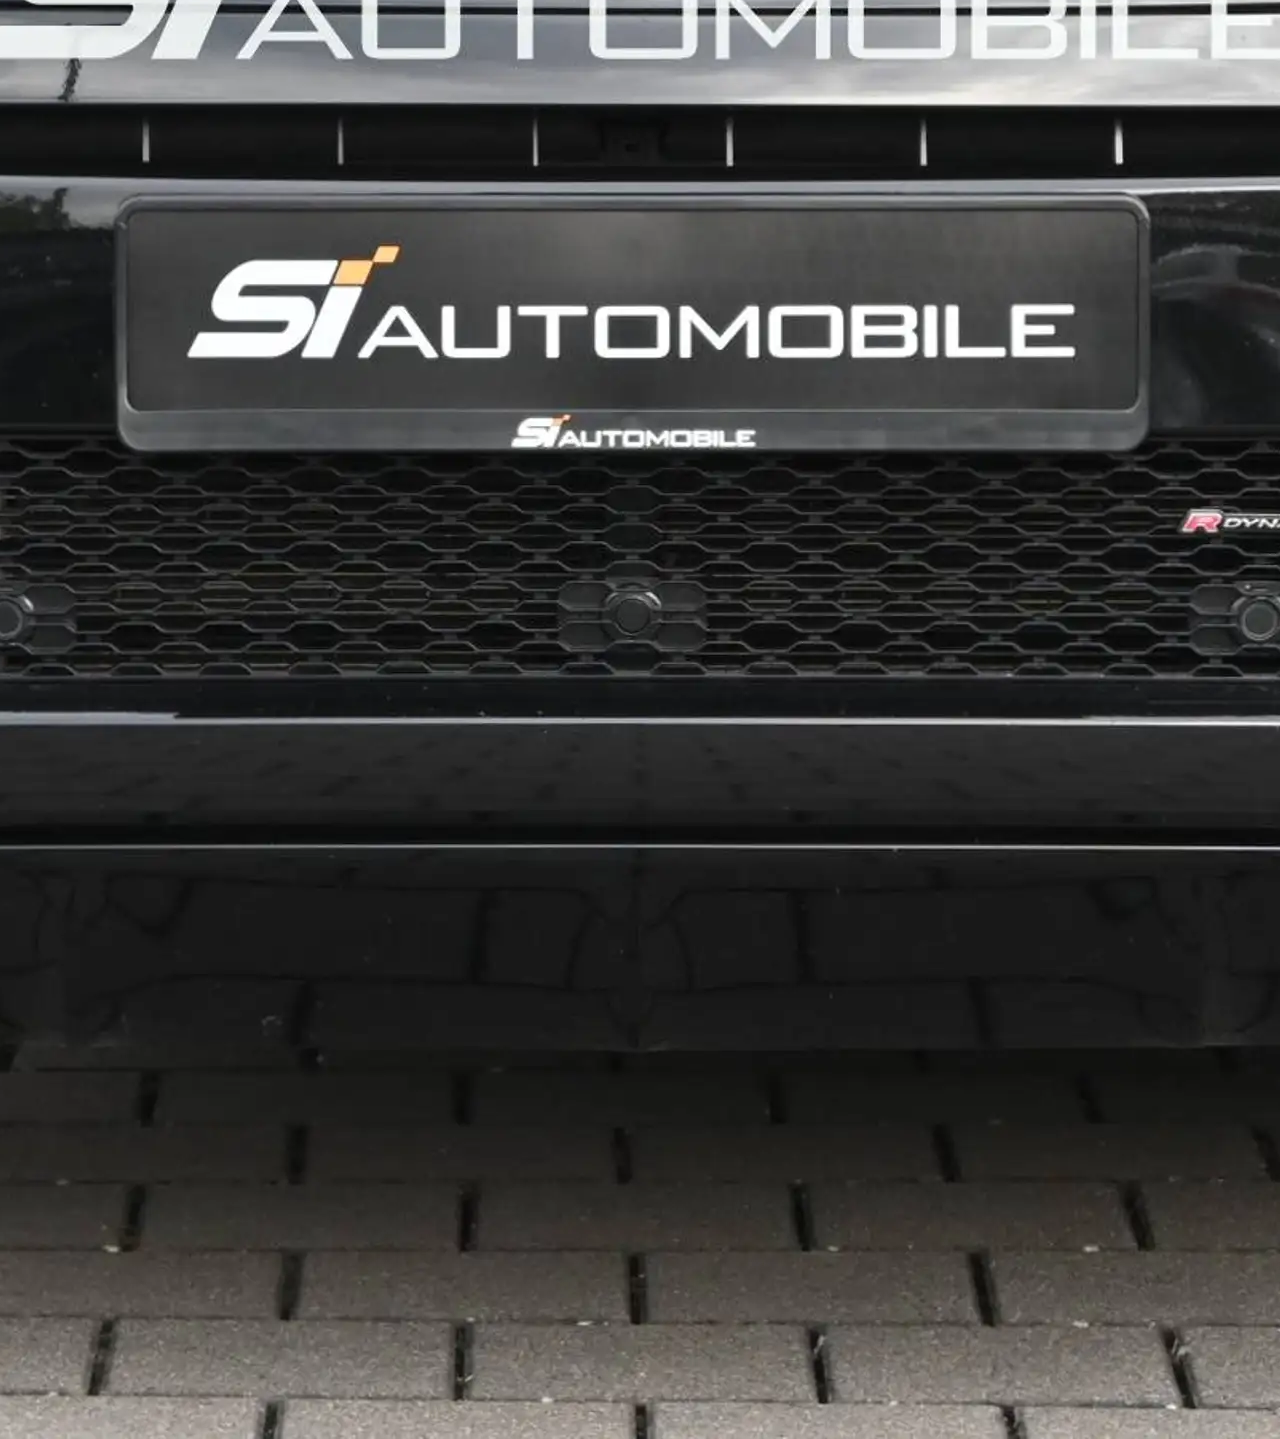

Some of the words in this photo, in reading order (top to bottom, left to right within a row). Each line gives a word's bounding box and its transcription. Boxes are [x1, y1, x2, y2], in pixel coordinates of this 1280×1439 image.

[357, 304, 1075, 359] AUTOMOBILE
[557, 429, 757, 449] AUTOMOBILE
[1181, 508, 1224, 534] R
